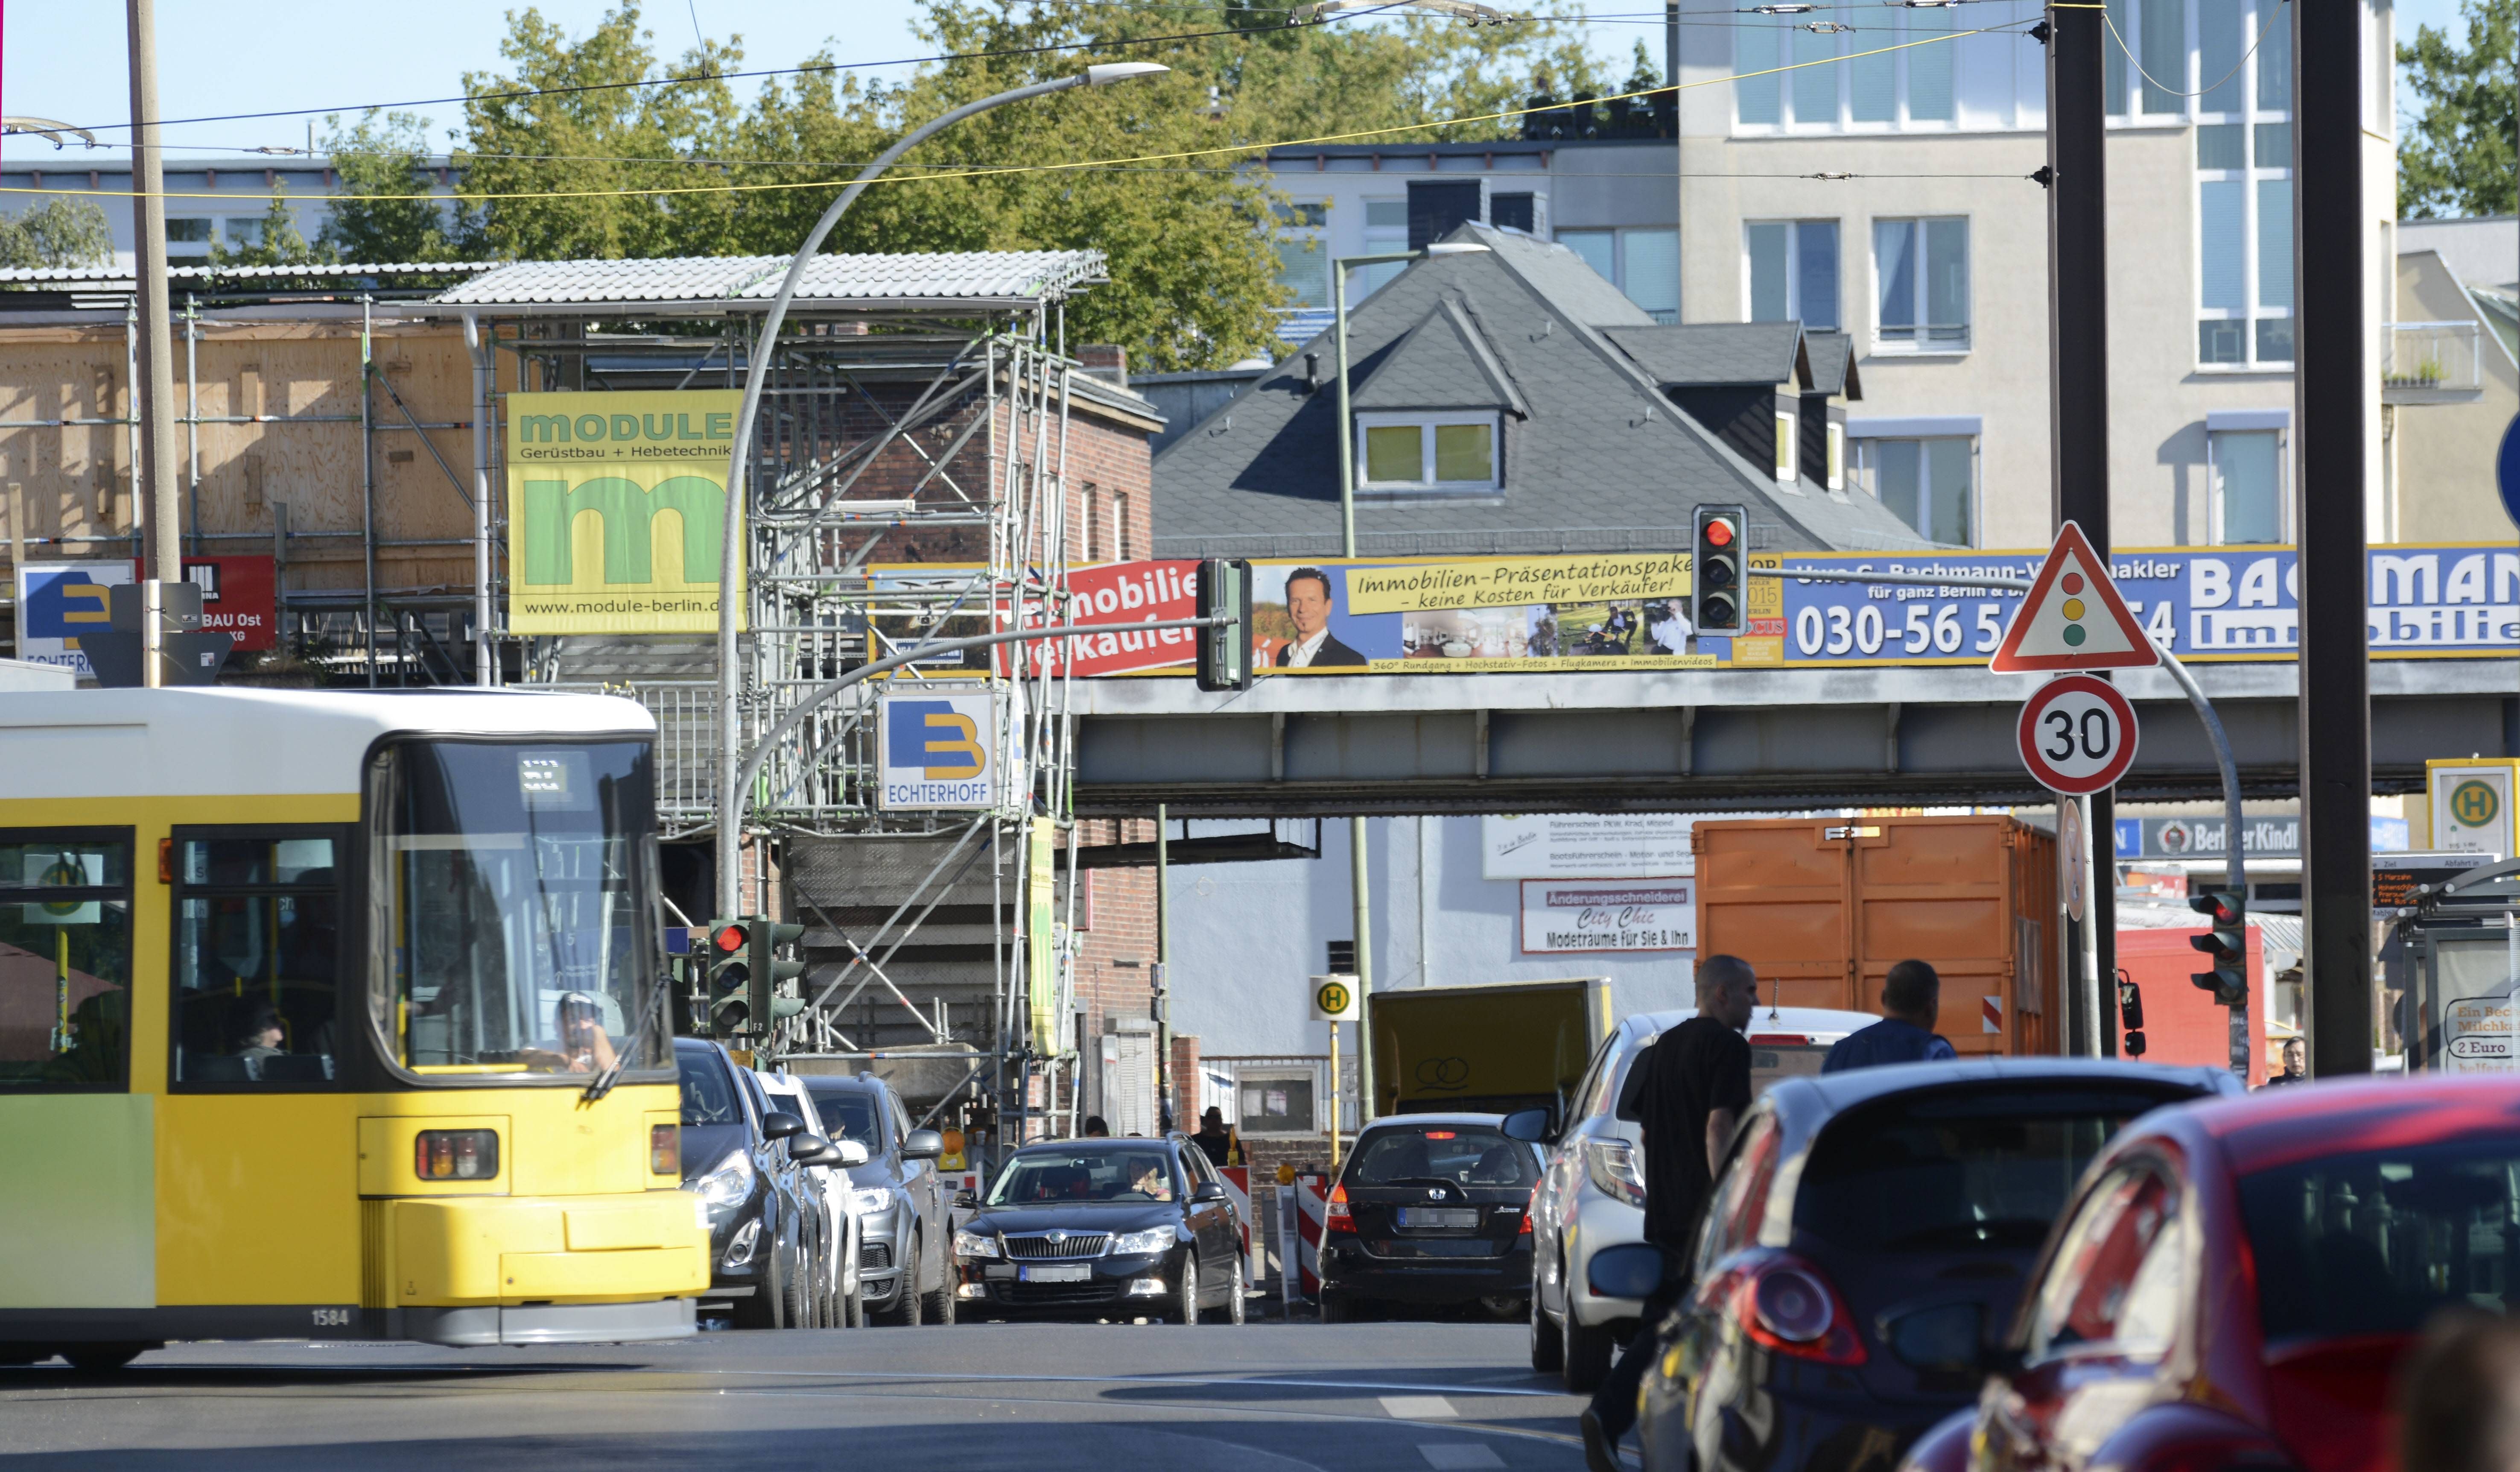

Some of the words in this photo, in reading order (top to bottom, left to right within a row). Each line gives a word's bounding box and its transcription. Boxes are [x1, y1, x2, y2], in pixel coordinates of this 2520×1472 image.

[520, 446, 605, 459] Gerüstbau
[631, 445, 731, 457] Hebetechnik
[1358, 554, 1693, 594] Immobilien-Präsentationspake
[1418, 592, 1465, 609] keine
[1474, 589, 1535, 605] Kosten
[1543, 584, 1571, 601] für
[1579, 577, 1673, 599] Verkäufer!
[1868, 586, 1892, 598] für
[1896, 588, 1935, 601] ganz
[1939, 585, 1986, 597] Berlin
[525, 600, 720, 614] www.module-berlin.d
[237, 614, 261, 626] Ost
[1796, 603, 1962, 655] 030-56
[1403, 661, 1451, 672] Rundgang
[1465, 660, 1548, 669] Hochstativ-Fotos
[1561, 658, 1617, 670] Flugkamera
[1630, 657, 1713, 667] Immobilienvideos
[2044, 708, 2110, 761] 30
[888, 783, 987, 804] ECHTERHOFF
[2463, 792, 2486, 817] H
[1550, 820, 1600, 828] Führerschein
[1647, 819, 1674, 828] Moped
[2256, 822, 2298, 851] Kindl
[1548, 891, 1685, 906] Änderungsschneiderei
[1577, 907, 1613, 929] City
[1618, 906, 1656, 929] Chic
[1546, 930, 1617, 948] Modeträume
[1622, 930, 1638, 948] für
[1641, 930, 1657, 947] Sie
[1661, 930, 1667, 945] &
[1671, 930, 1689, 945] Ihn
[1326, 990, 1340, 1007] H
[2457, 1007, 2481, 1018] Ein
[2458, 1042, 2465, 1053] 2
[2470, 1042, 2506, 1053] Euro
[312, 1309, 349, 1326] 1584
